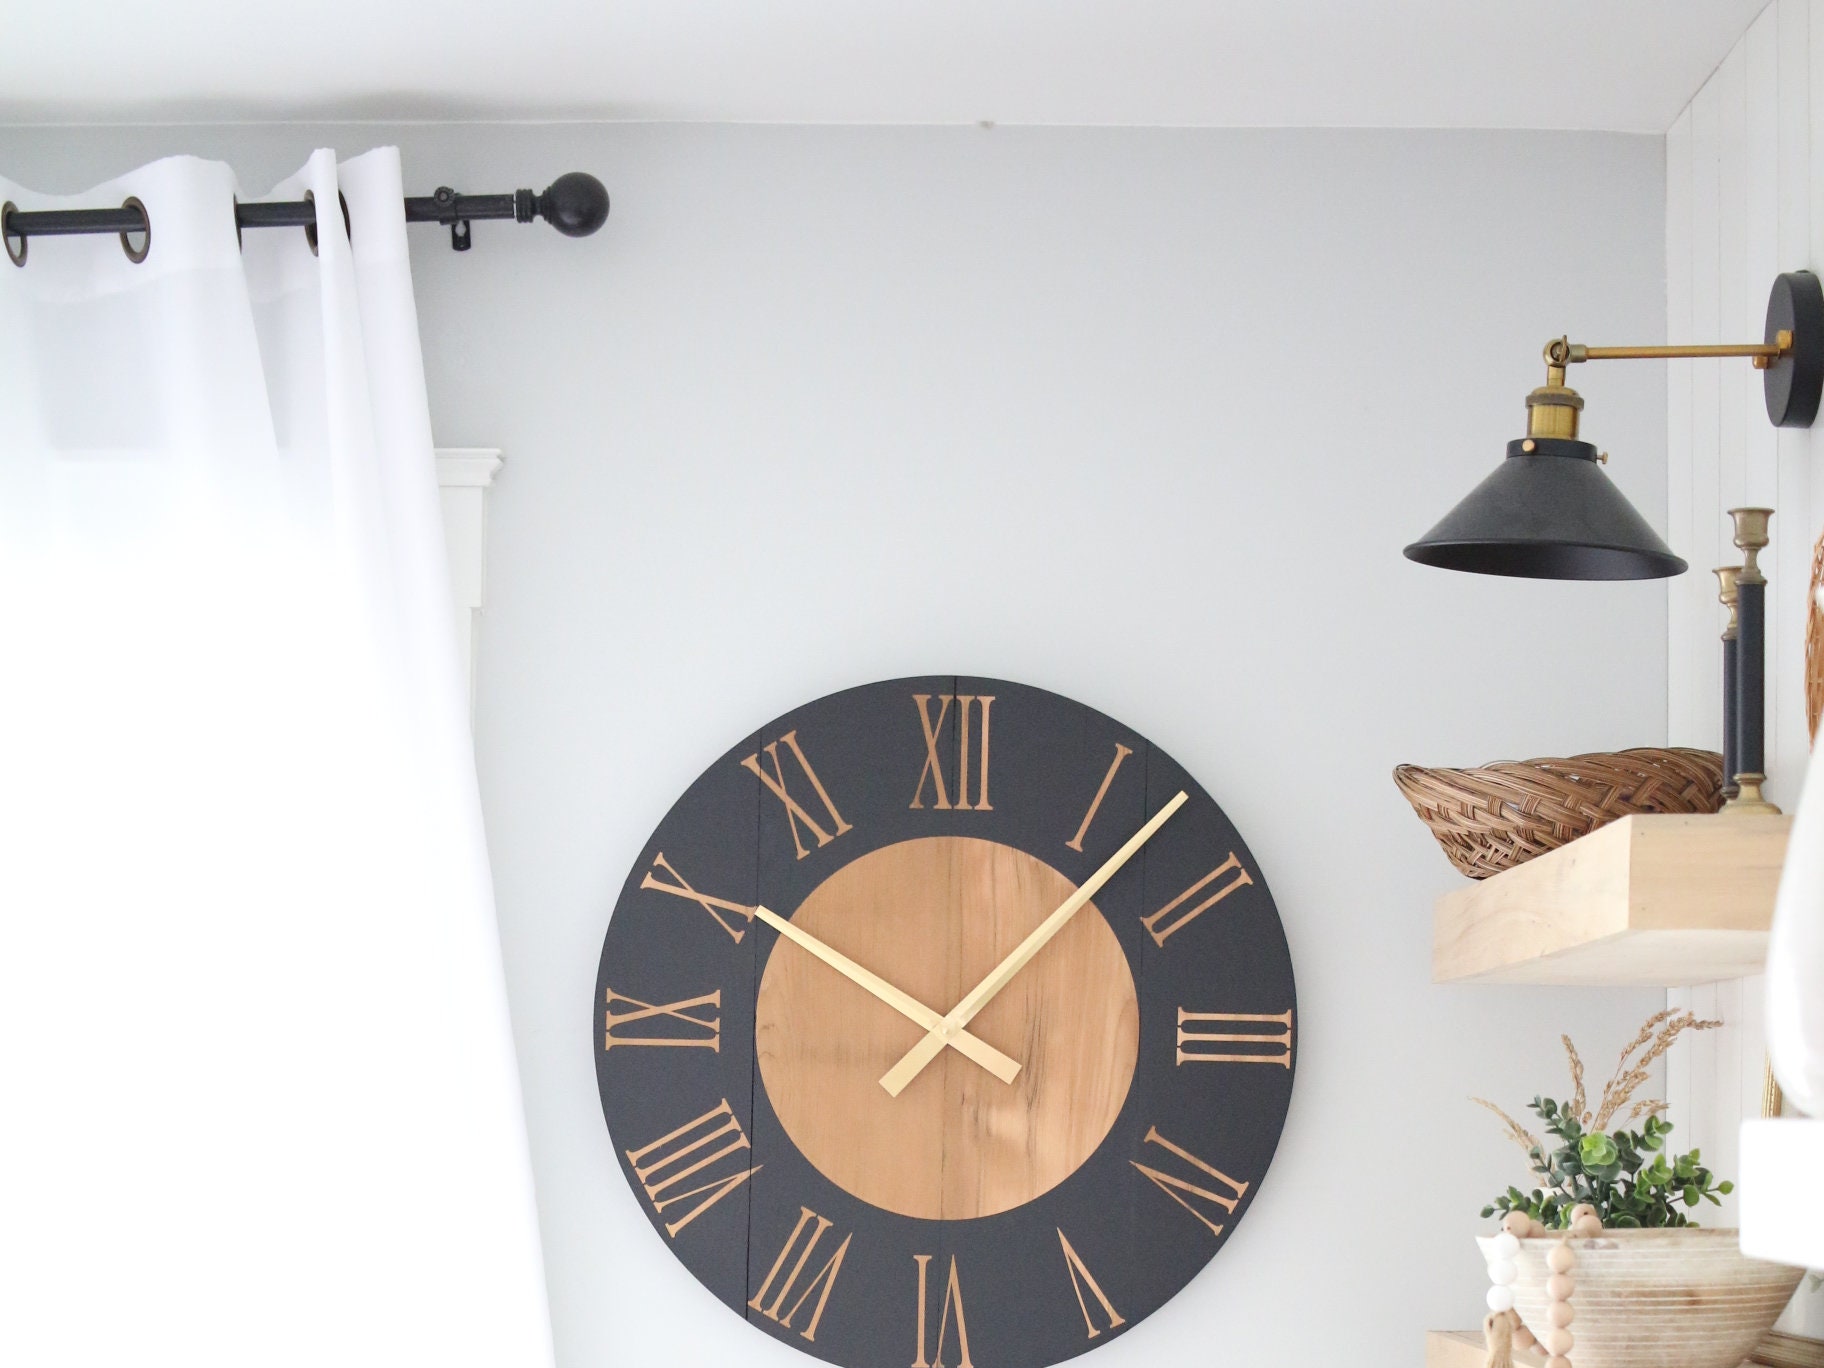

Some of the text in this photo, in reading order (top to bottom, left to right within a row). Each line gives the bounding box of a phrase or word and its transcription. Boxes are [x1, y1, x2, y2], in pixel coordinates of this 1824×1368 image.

[741, 730, 853, 861] XI
[908, 693, 996, 812] XII
[1066, 743, 1132, 853] I
[639, 851, 758, 945] X
[1141, 851, 1253, 948] II
[605, 988, 721, 1053] IX
[1176, 1007, 1292, 1069] III
[625, 1097, 764, 1239] VIII
[1128, 1125, 1250, 1236] IV
[746, 1205, 853, 1343] VII
[1057, 1226, 1126, 1339] V
